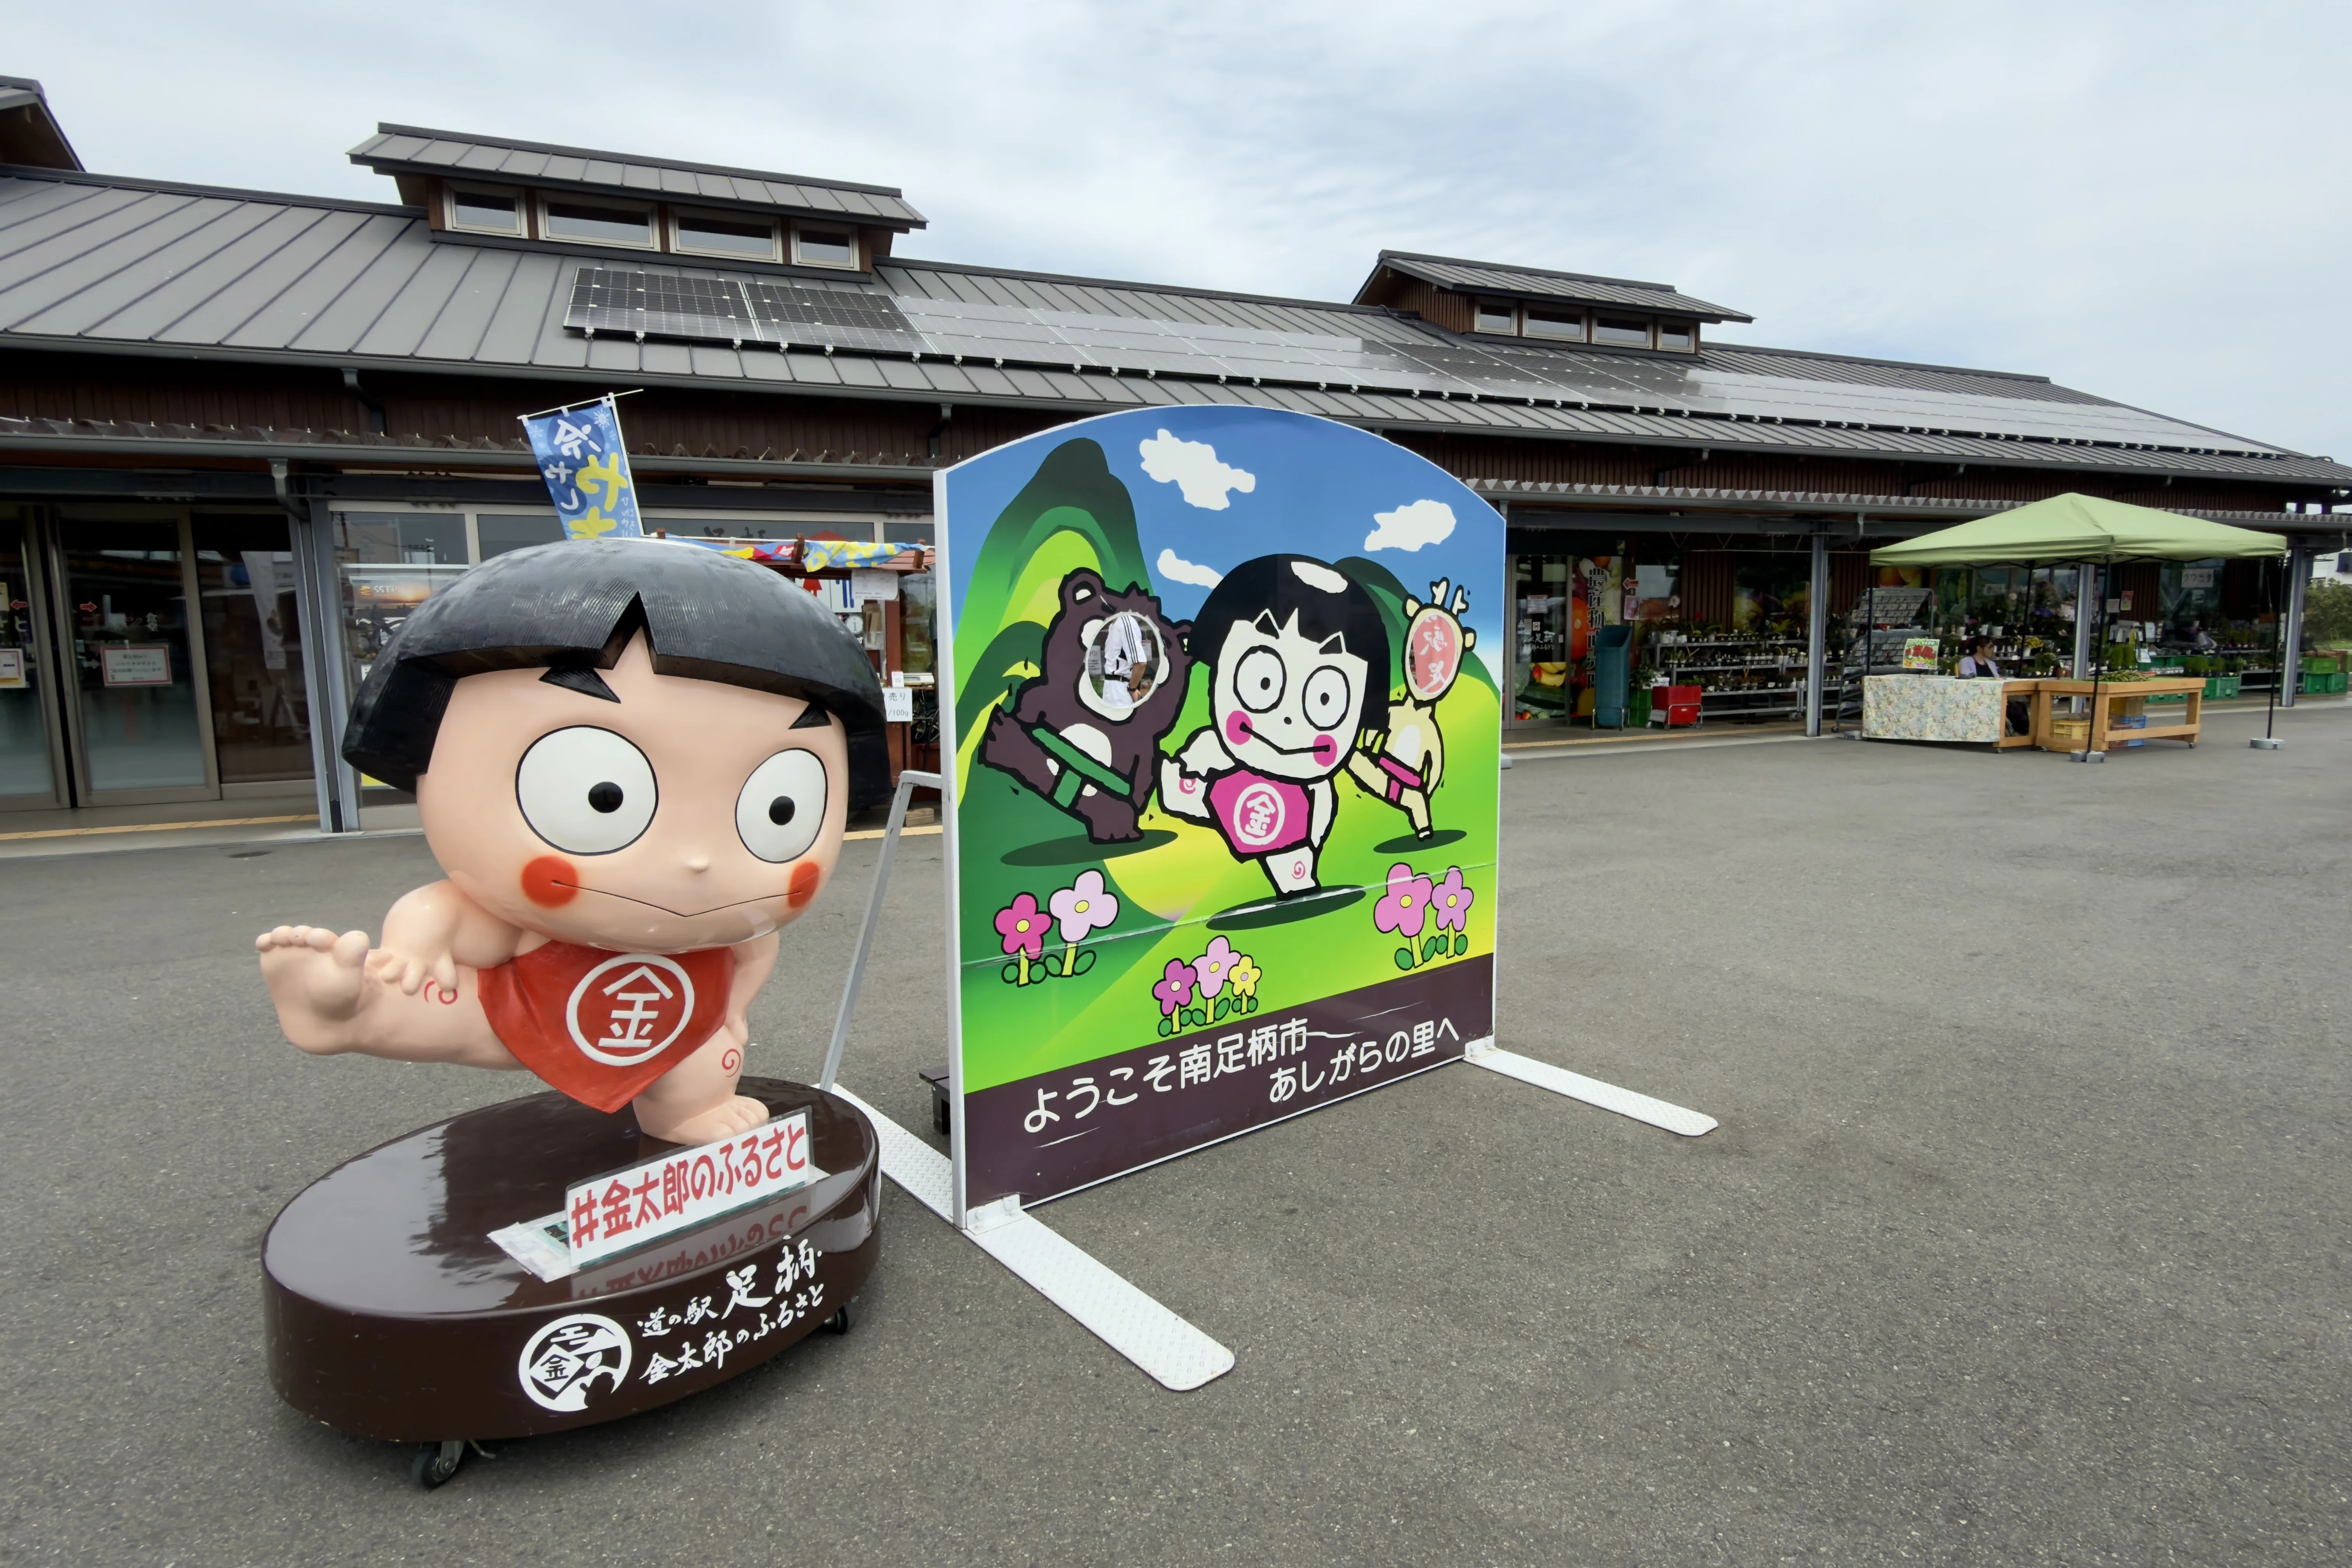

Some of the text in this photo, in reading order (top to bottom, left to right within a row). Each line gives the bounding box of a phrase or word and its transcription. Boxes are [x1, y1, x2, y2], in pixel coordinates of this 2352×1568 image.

[888, 709, 909, 717] /100g
[1245, 794, 1276, 837] 金
[598, 965, 674, 1047] 金
[1024, 1018, 1308, 1133] ようこそ南足柄市
[1269, 1017, 1459, 1103] あしがらの里へ
[540, 1354, 571, 1382] 金
[639, 1284, 824, 1385] 金太郎のふるさと
